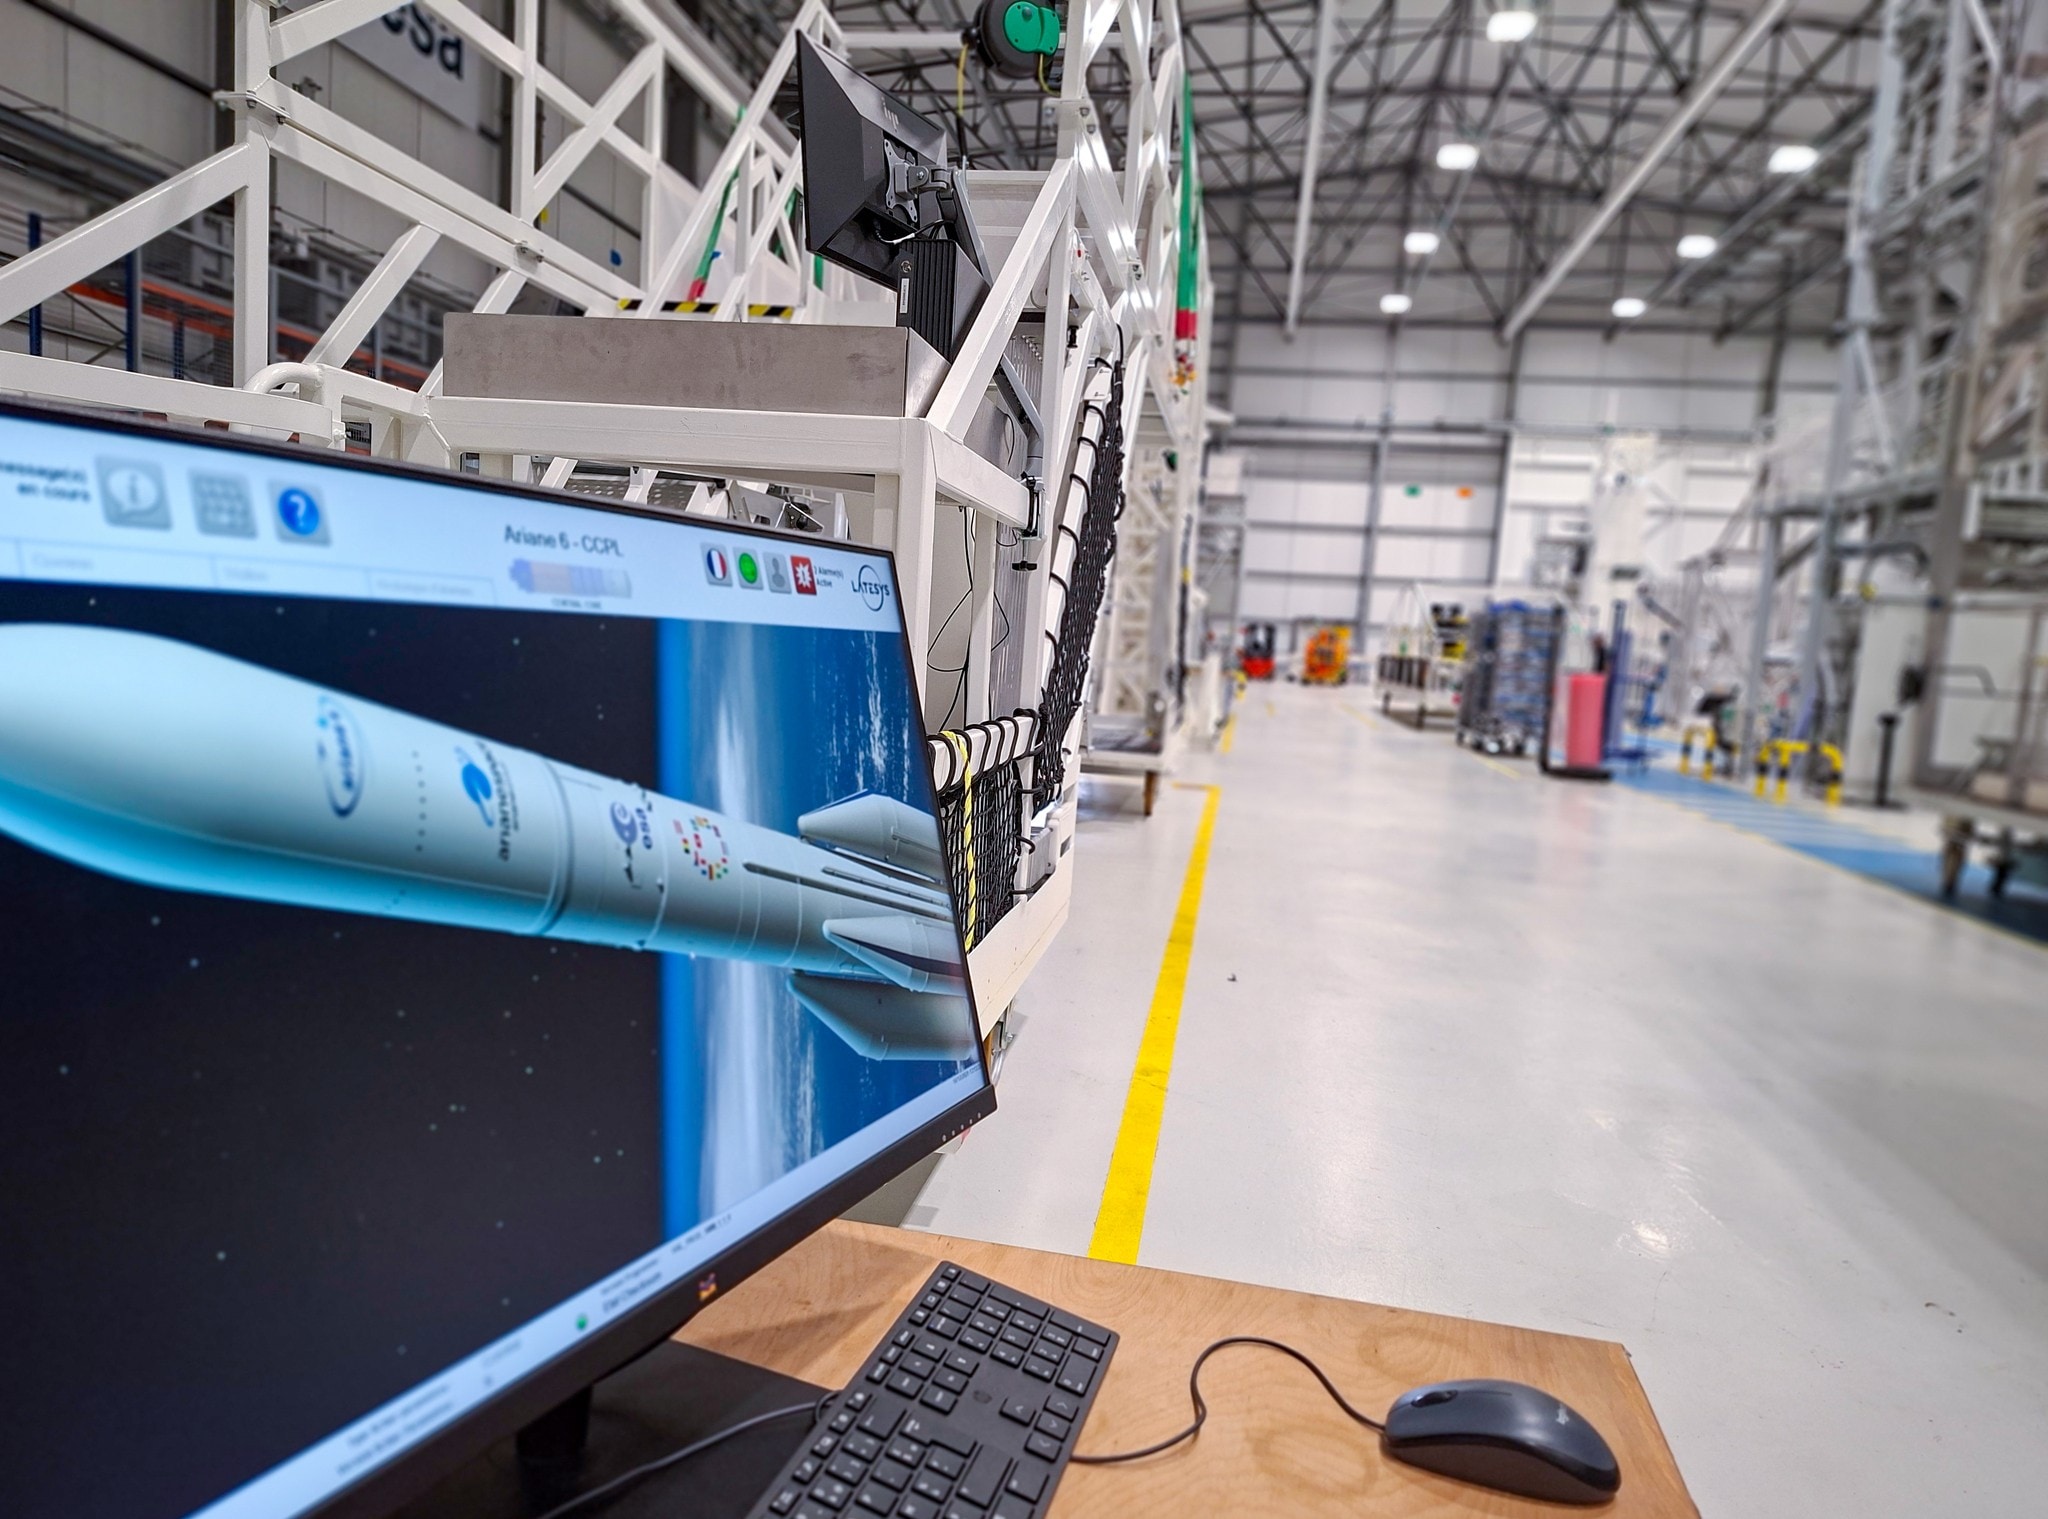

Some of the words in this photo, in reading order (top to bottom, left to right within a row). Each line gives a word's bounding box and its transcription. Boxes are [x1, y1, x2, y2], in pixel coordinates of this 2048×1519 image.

[504, 524, 556, 548] Ariane
[559, 531, 570, 550] 6
[581, 534, 624, 557] CCPL
[851, 579, 890, 597] LATESYS
